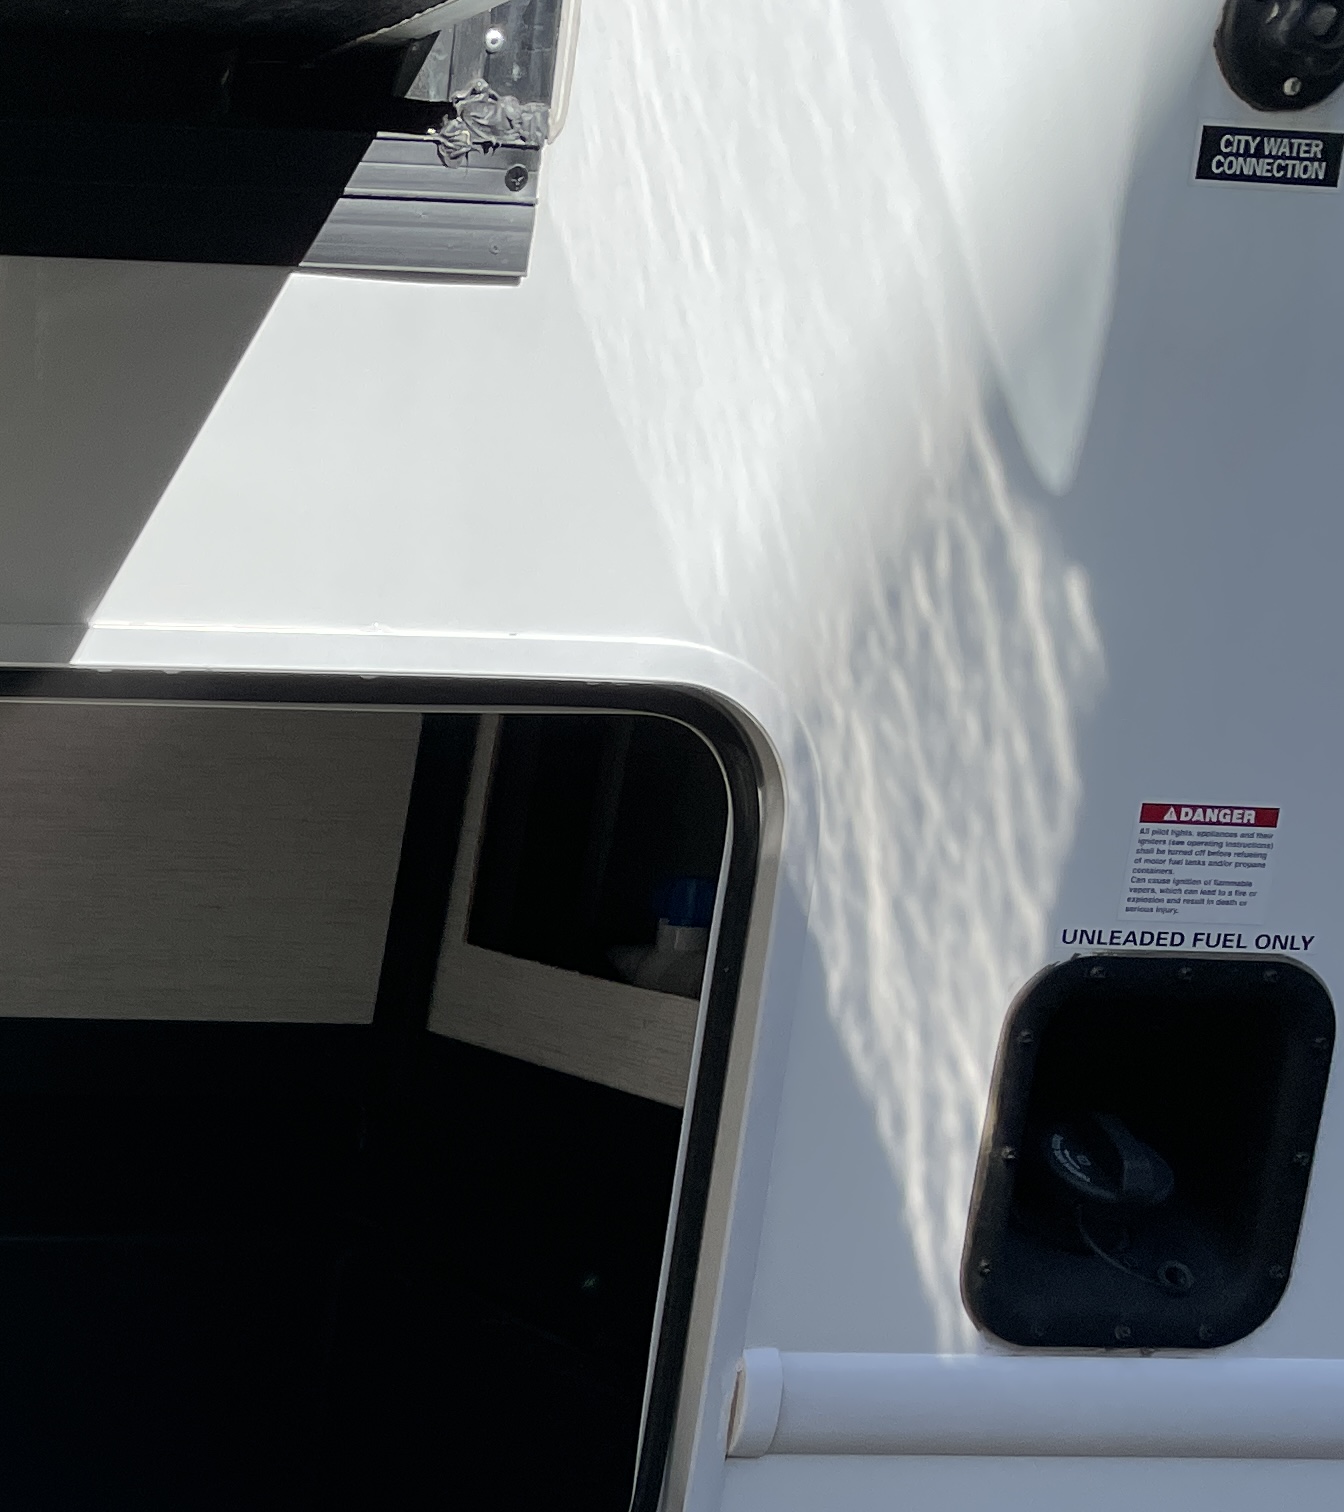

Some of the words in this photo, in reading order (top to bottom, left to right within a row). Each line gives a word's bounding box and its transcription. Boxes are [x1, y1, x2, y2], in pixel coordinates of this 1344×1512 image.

[1220, 134, 1261, 154] CITY
[1264, 137, 1323, 158] WATER
[1212, 156, 1326, 179] CONNECTION
[1180, 808, 1255, 823] DANGER
[1062, 929, 1185, 947] UNLEADED
[1192, 932, 1247, 948] FUEL
[1255, 934, 1315, 950] ONLY
